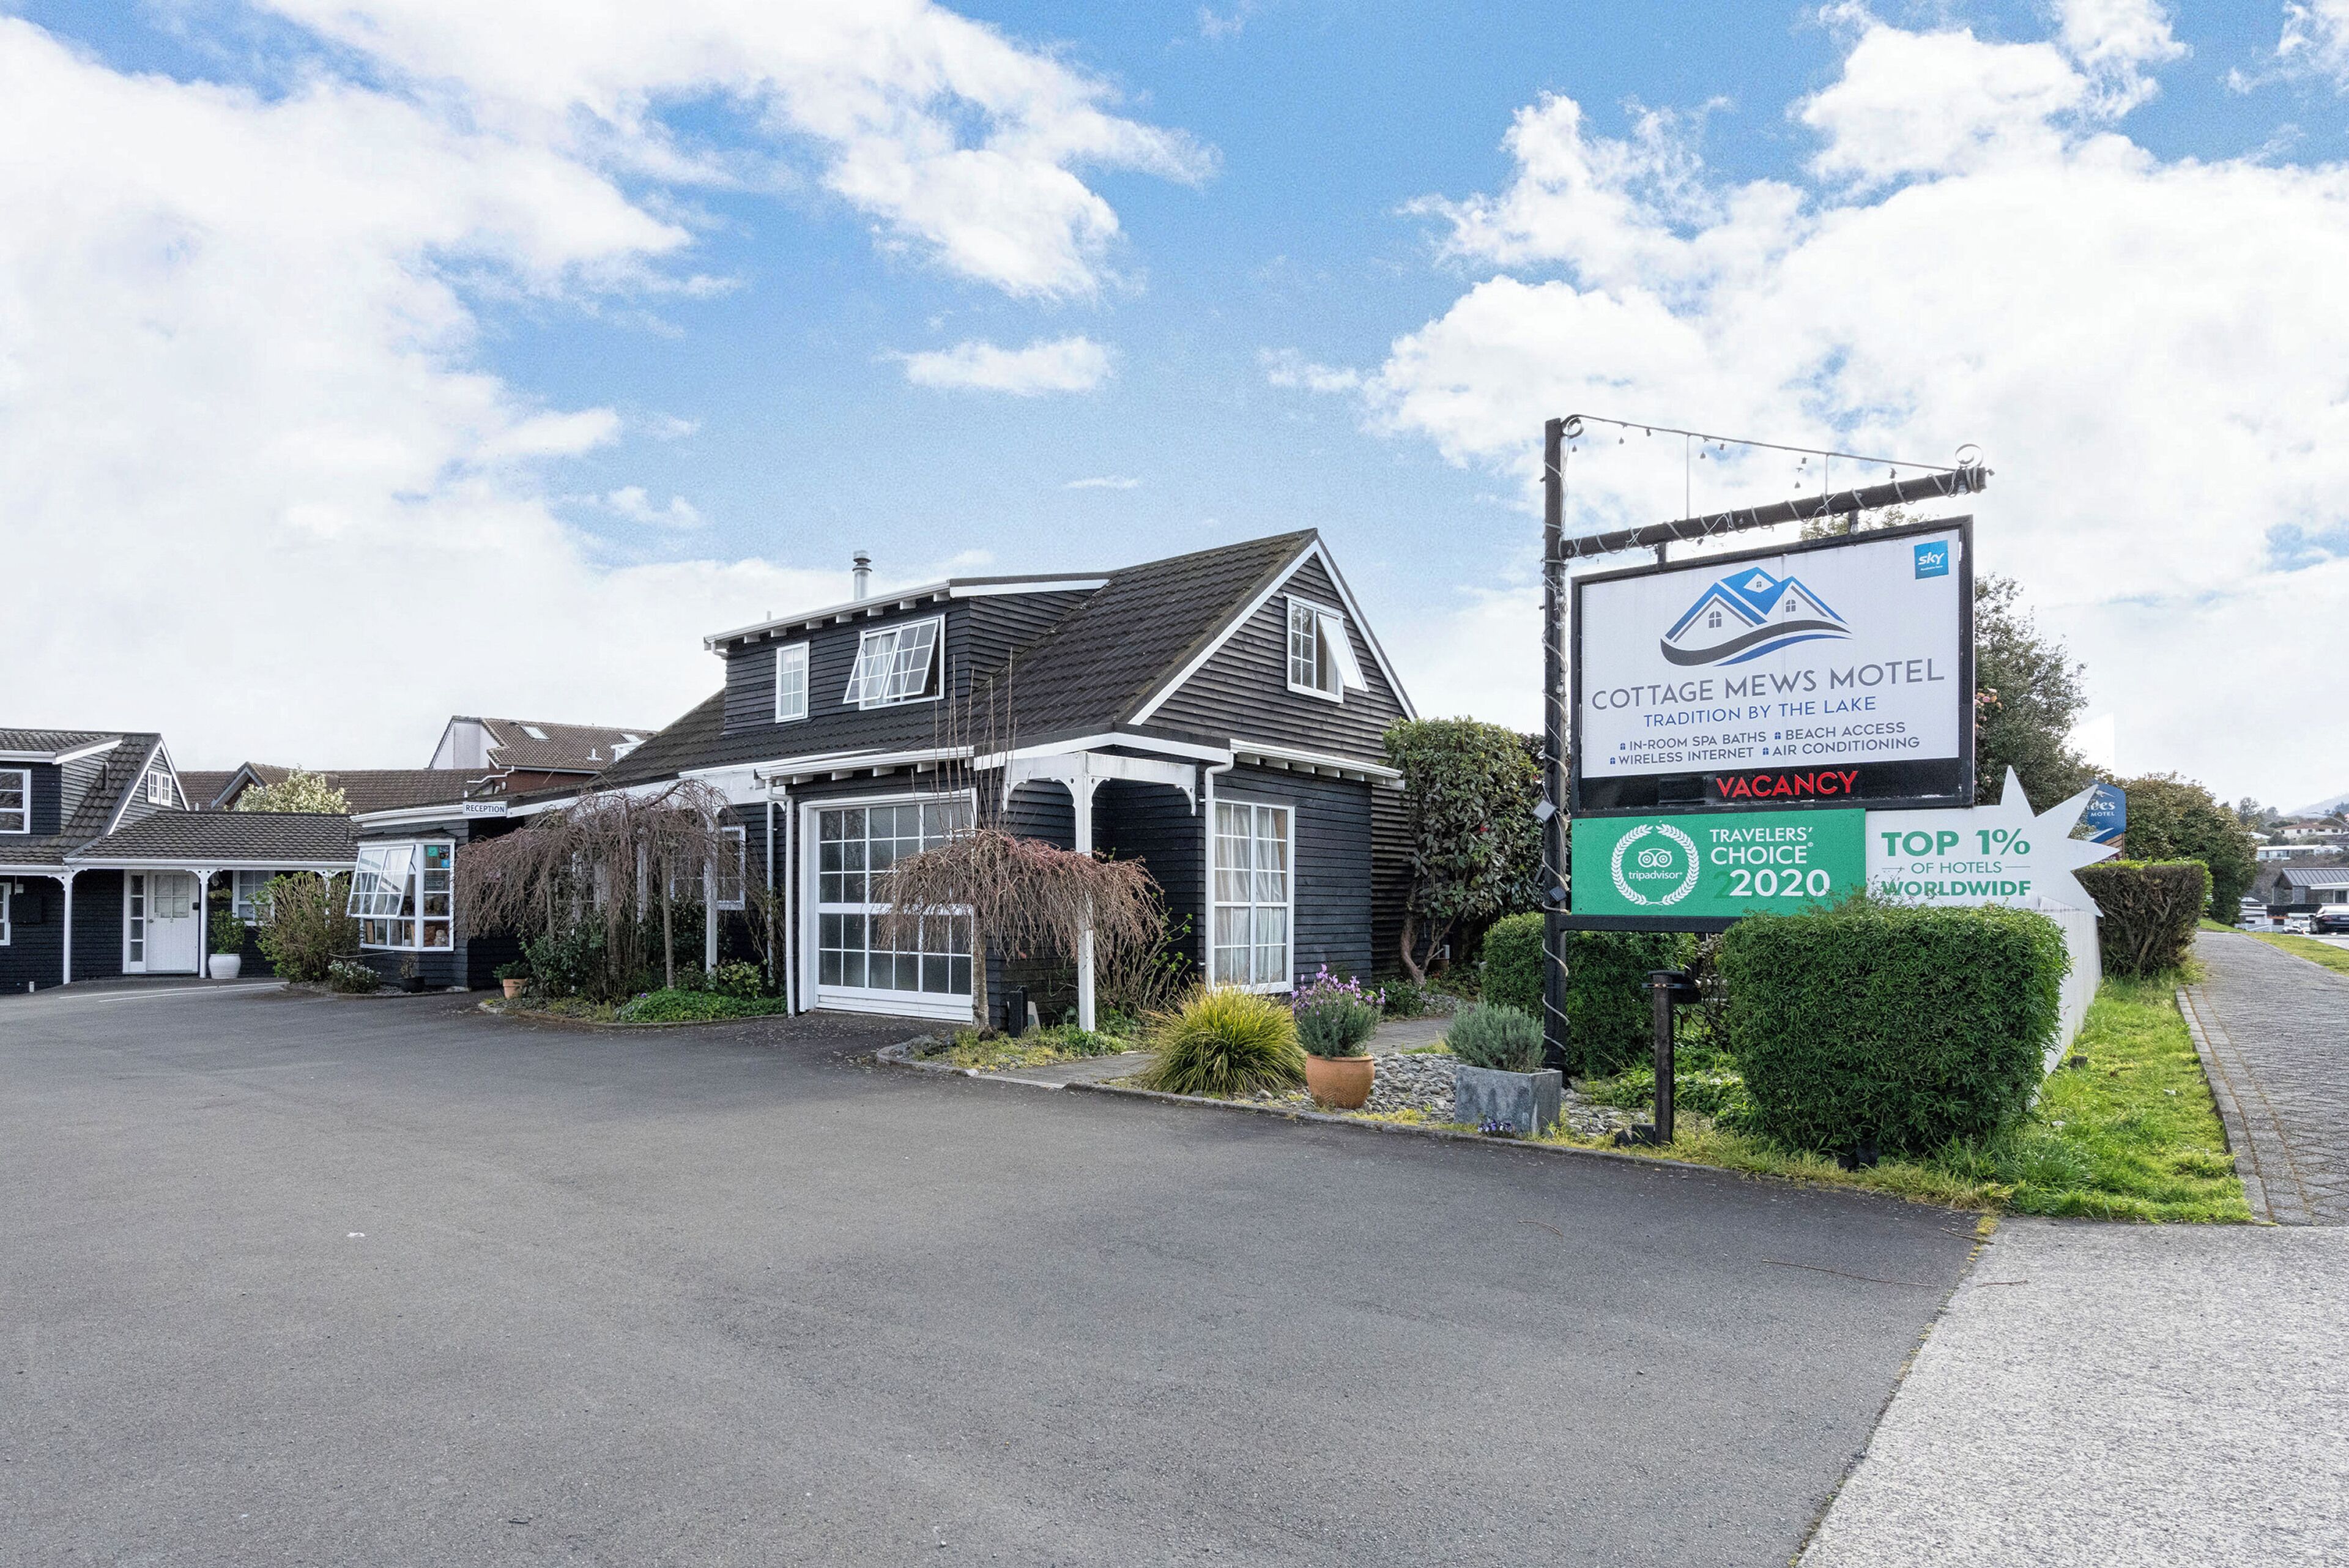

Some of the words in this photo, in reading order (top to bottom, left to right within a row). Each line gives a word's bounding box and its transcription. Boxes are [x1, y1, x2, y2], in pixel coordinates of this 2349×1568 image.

[1918, 551, 1945, 565] sky
[1592, 679, 1713, 710] COTTAGE
[1725, 670, 1817, 699] MEWS
[1830, 658, 1945, 690] MOTEL
[1644, 707, 1741, 728] TRADITION
[1749, 704, 1771, 719] BY
[1779, 701, 1816, 717] THE
[1824, 696, 1877, 714] LAKE
[1630, 738, 1688, 751] IN-ROOM
[1693, 735, 1718, 747] SPA
[1723, 731, 1767, 745] BATHS
[1786, 727, 1837, 741] BEACH
[1842, 721, 1906, 737] ACCESS
[1619, 751, 1683, 765] WIRELESS
[1688, 747, 1754, 762] INTERNET
[1772, 744, 1798, 757] AIR
[1802, 737, 1920, 755] CONDITIONING
[1715, 770, 1859, 798] VACANCY
[466, 804, 505, 813] RECEPTION
[1710, 827, 1813, 843] TRAVELERS'
[1881, 830, 1959, 856] TOP
[1975, 828, 2031, 855] 1%
[1628, 870, 1679, 882] tripadvisor
[1911, 861, 1934, 874] OF
[1940, 861, 2002, 874] HOTELS
[1729, 868, 1831, 897] 2020
[1881, 880, 2032, 897] WORLDWIDE
